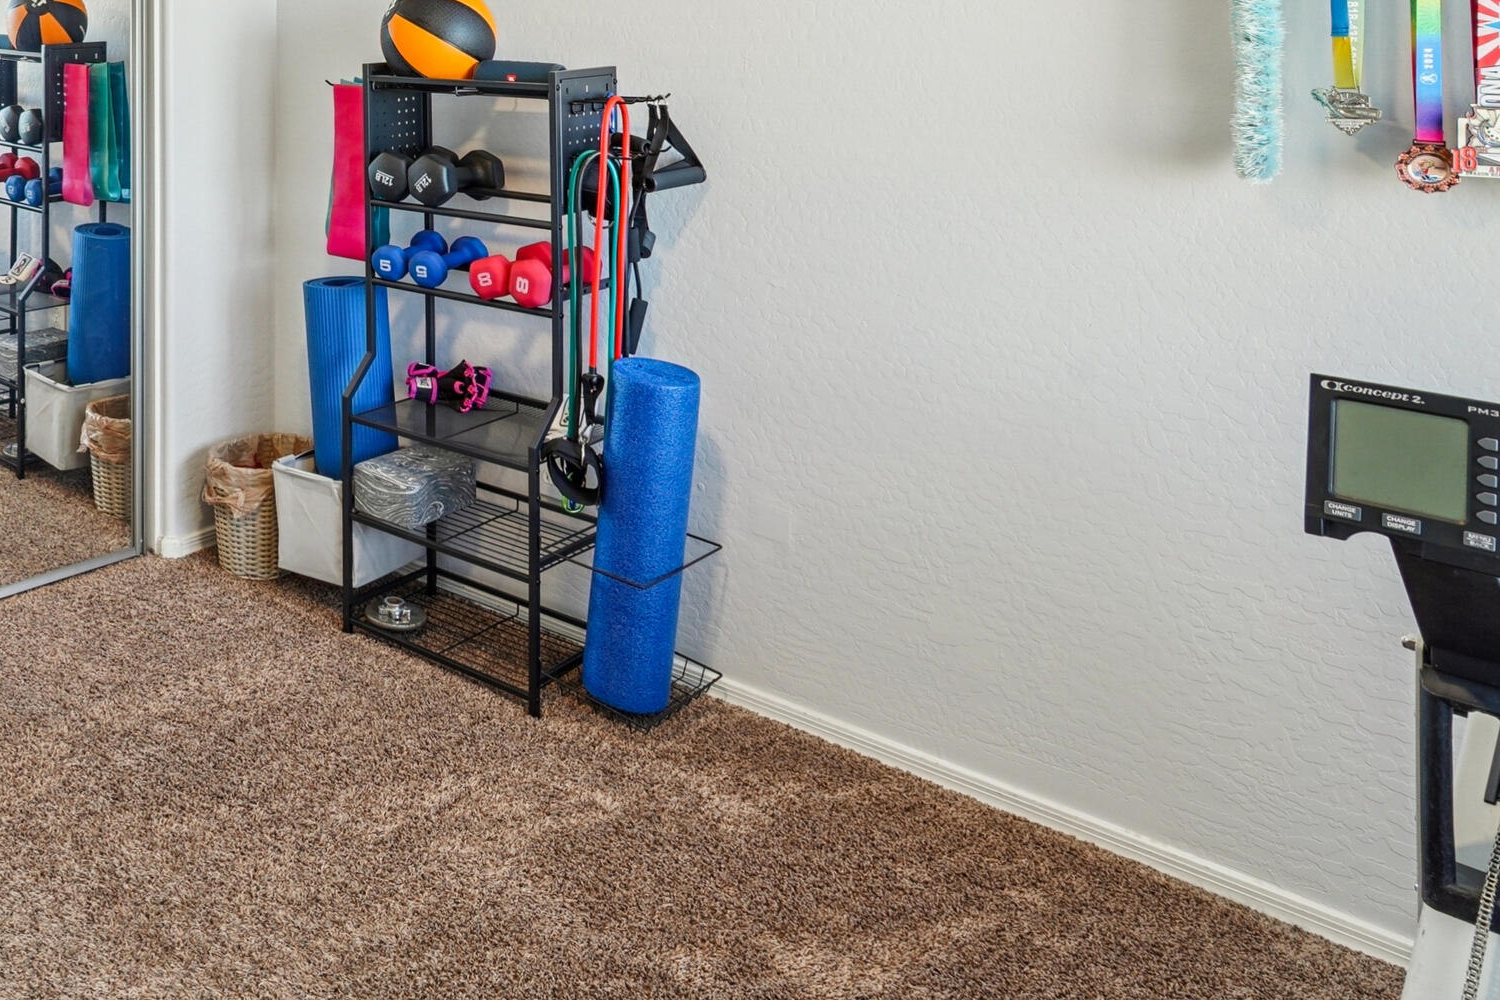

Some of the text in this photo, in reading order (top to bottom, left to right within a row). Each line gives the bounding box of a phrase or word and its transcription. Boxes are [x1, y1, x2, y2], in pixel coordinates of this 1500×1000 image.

[1451, 146, 1476, 172] 18
[375, 170, 393, 187] 12LB
[415, 174, 433, 193] 12LB
[379, 259, 392, 272] 5
[415, 265, 428, 279] 5
[477, 272, 493, 287] 8
[515, 276, 529, 295] 8
[1344, 382, 1410, 402] concept
[1467, 405, 1500, 418] PM3
[1328, 502, 1356, 514] CHANGE
[1331, 508, 1353, 519] UNITS
[1386, 515, 1417, 527] CHANGE
[1386, 521, 1416, 533] DISPLAY
